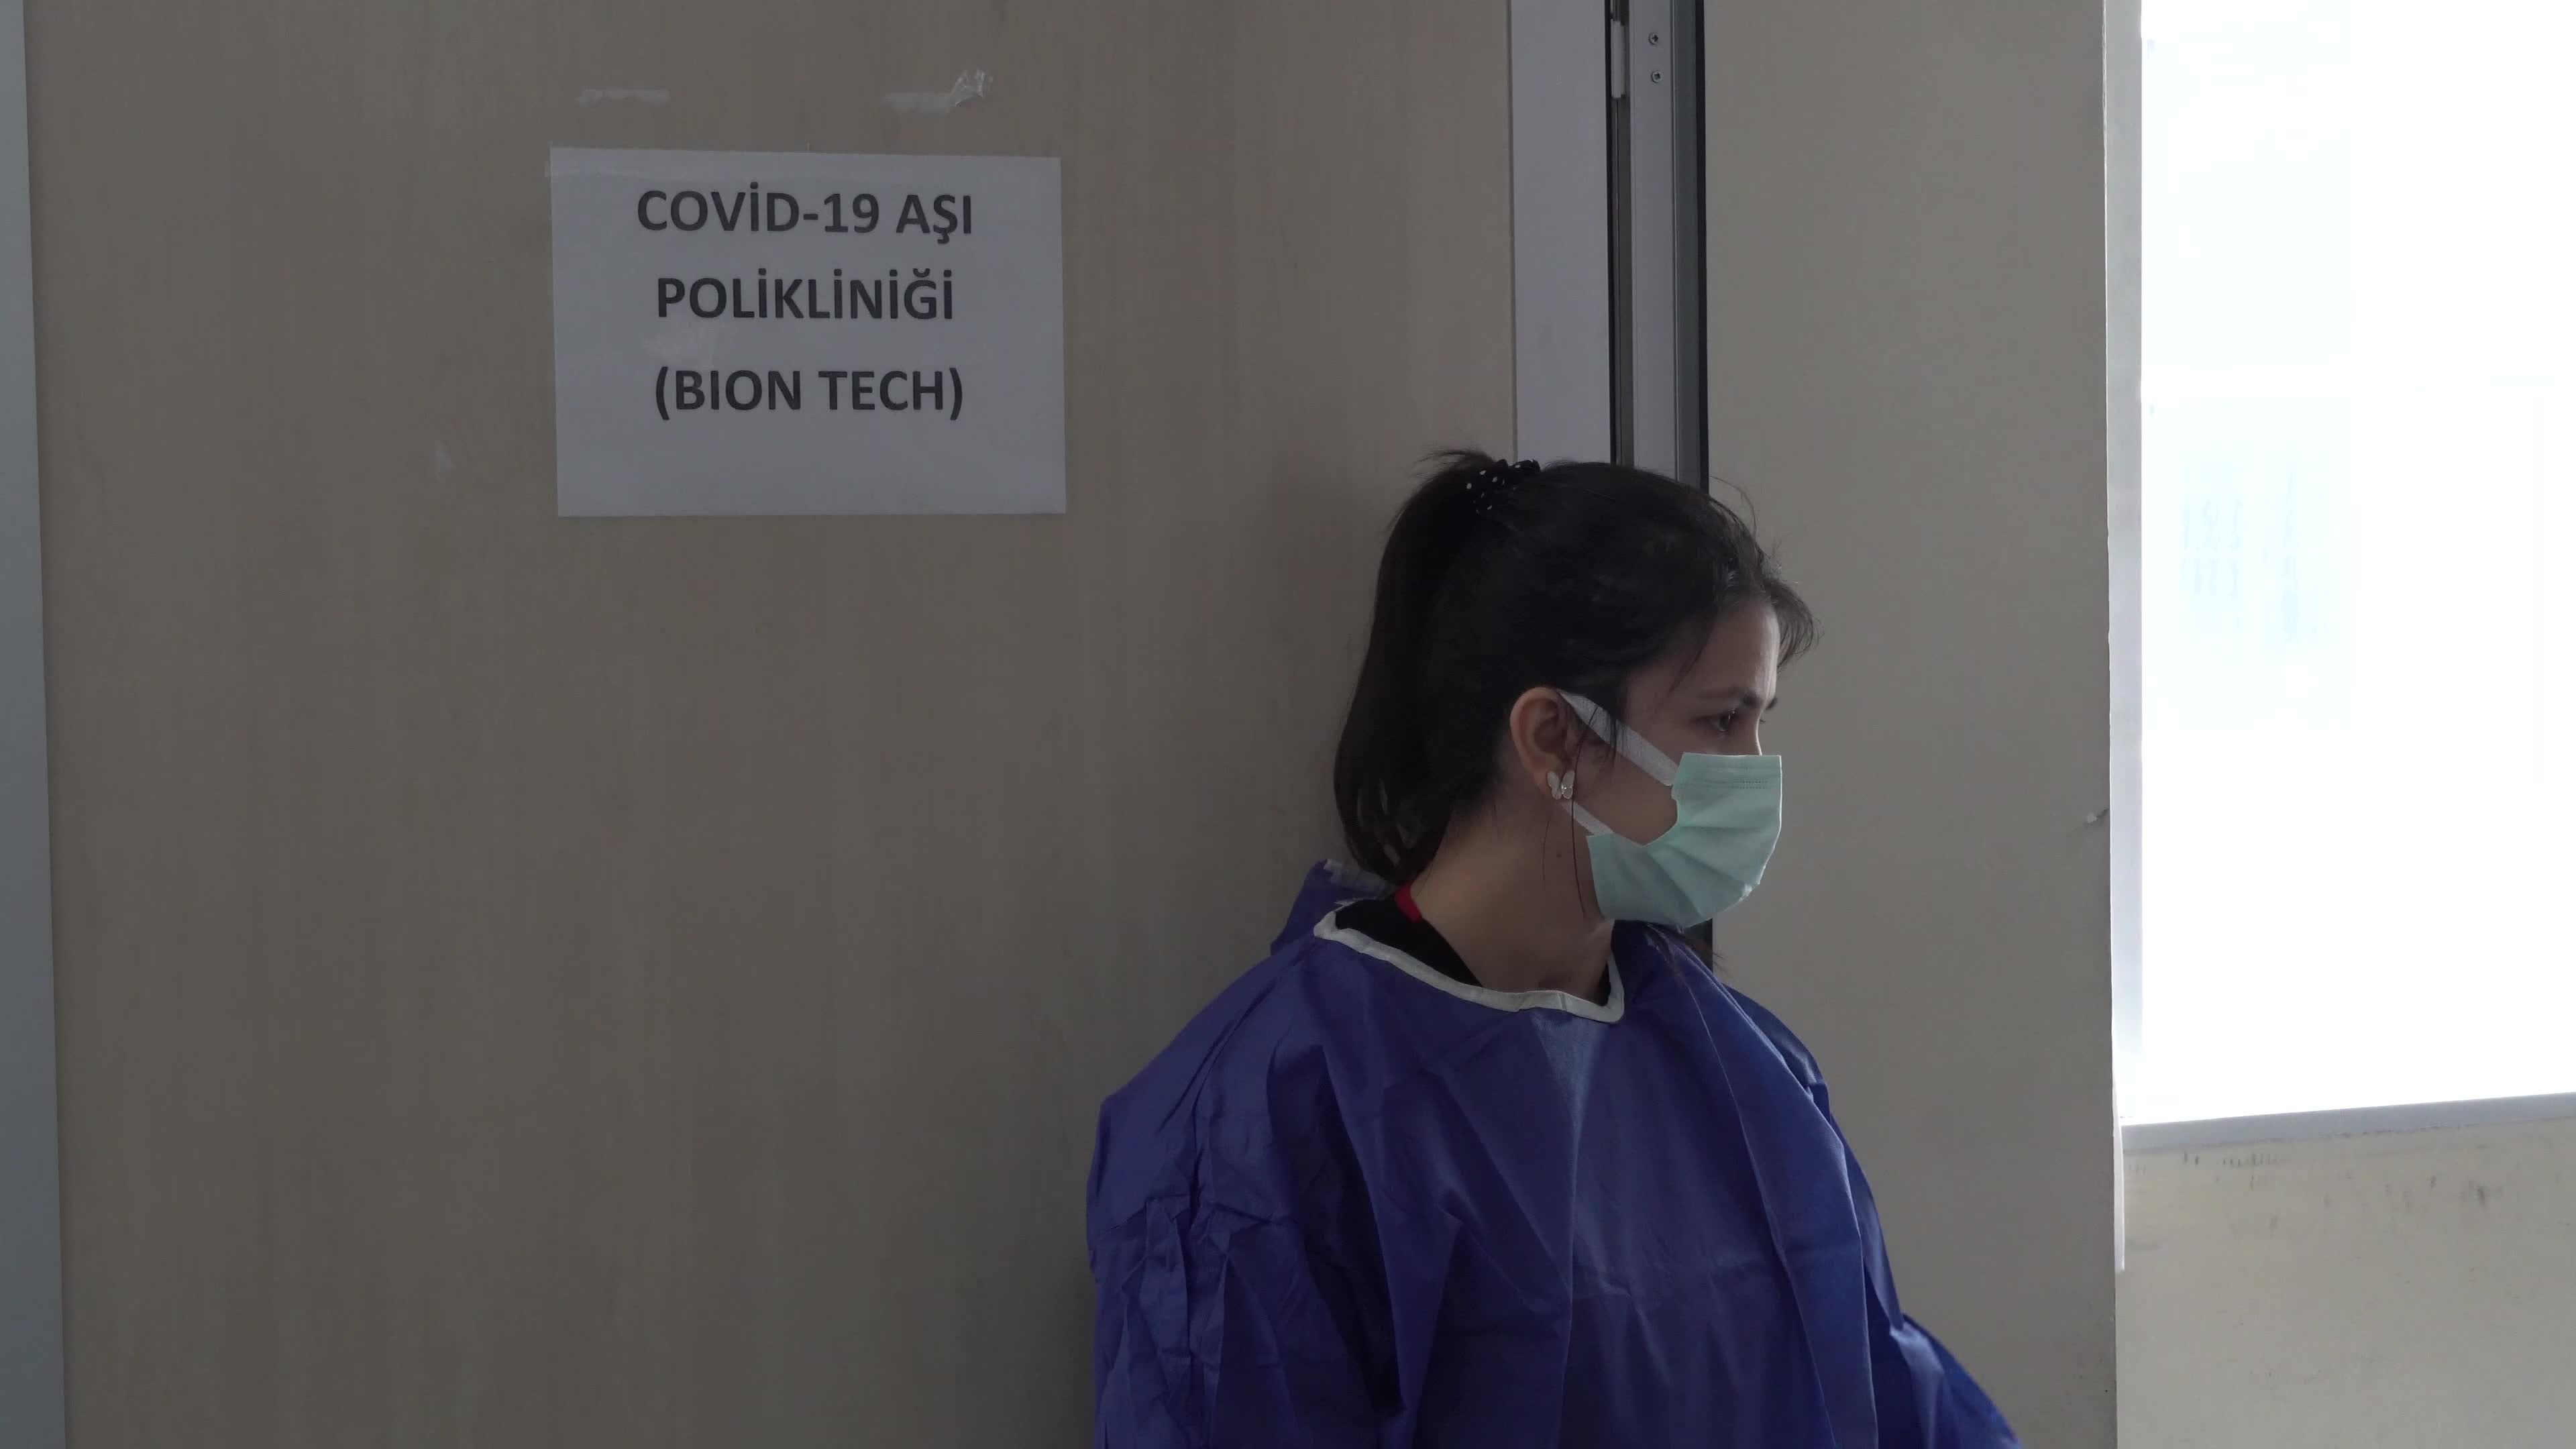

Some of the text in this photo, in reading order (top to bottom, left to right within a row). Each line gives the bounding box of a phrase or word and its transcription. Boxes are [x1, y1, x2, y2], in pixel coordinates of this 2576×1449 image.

[637, 181, 972, 245] COVİD-19 AŞI
[657, 266, 953, 321] POLİKLİNİĞİ
[654, 366, 963, 422] (BION TECH)
